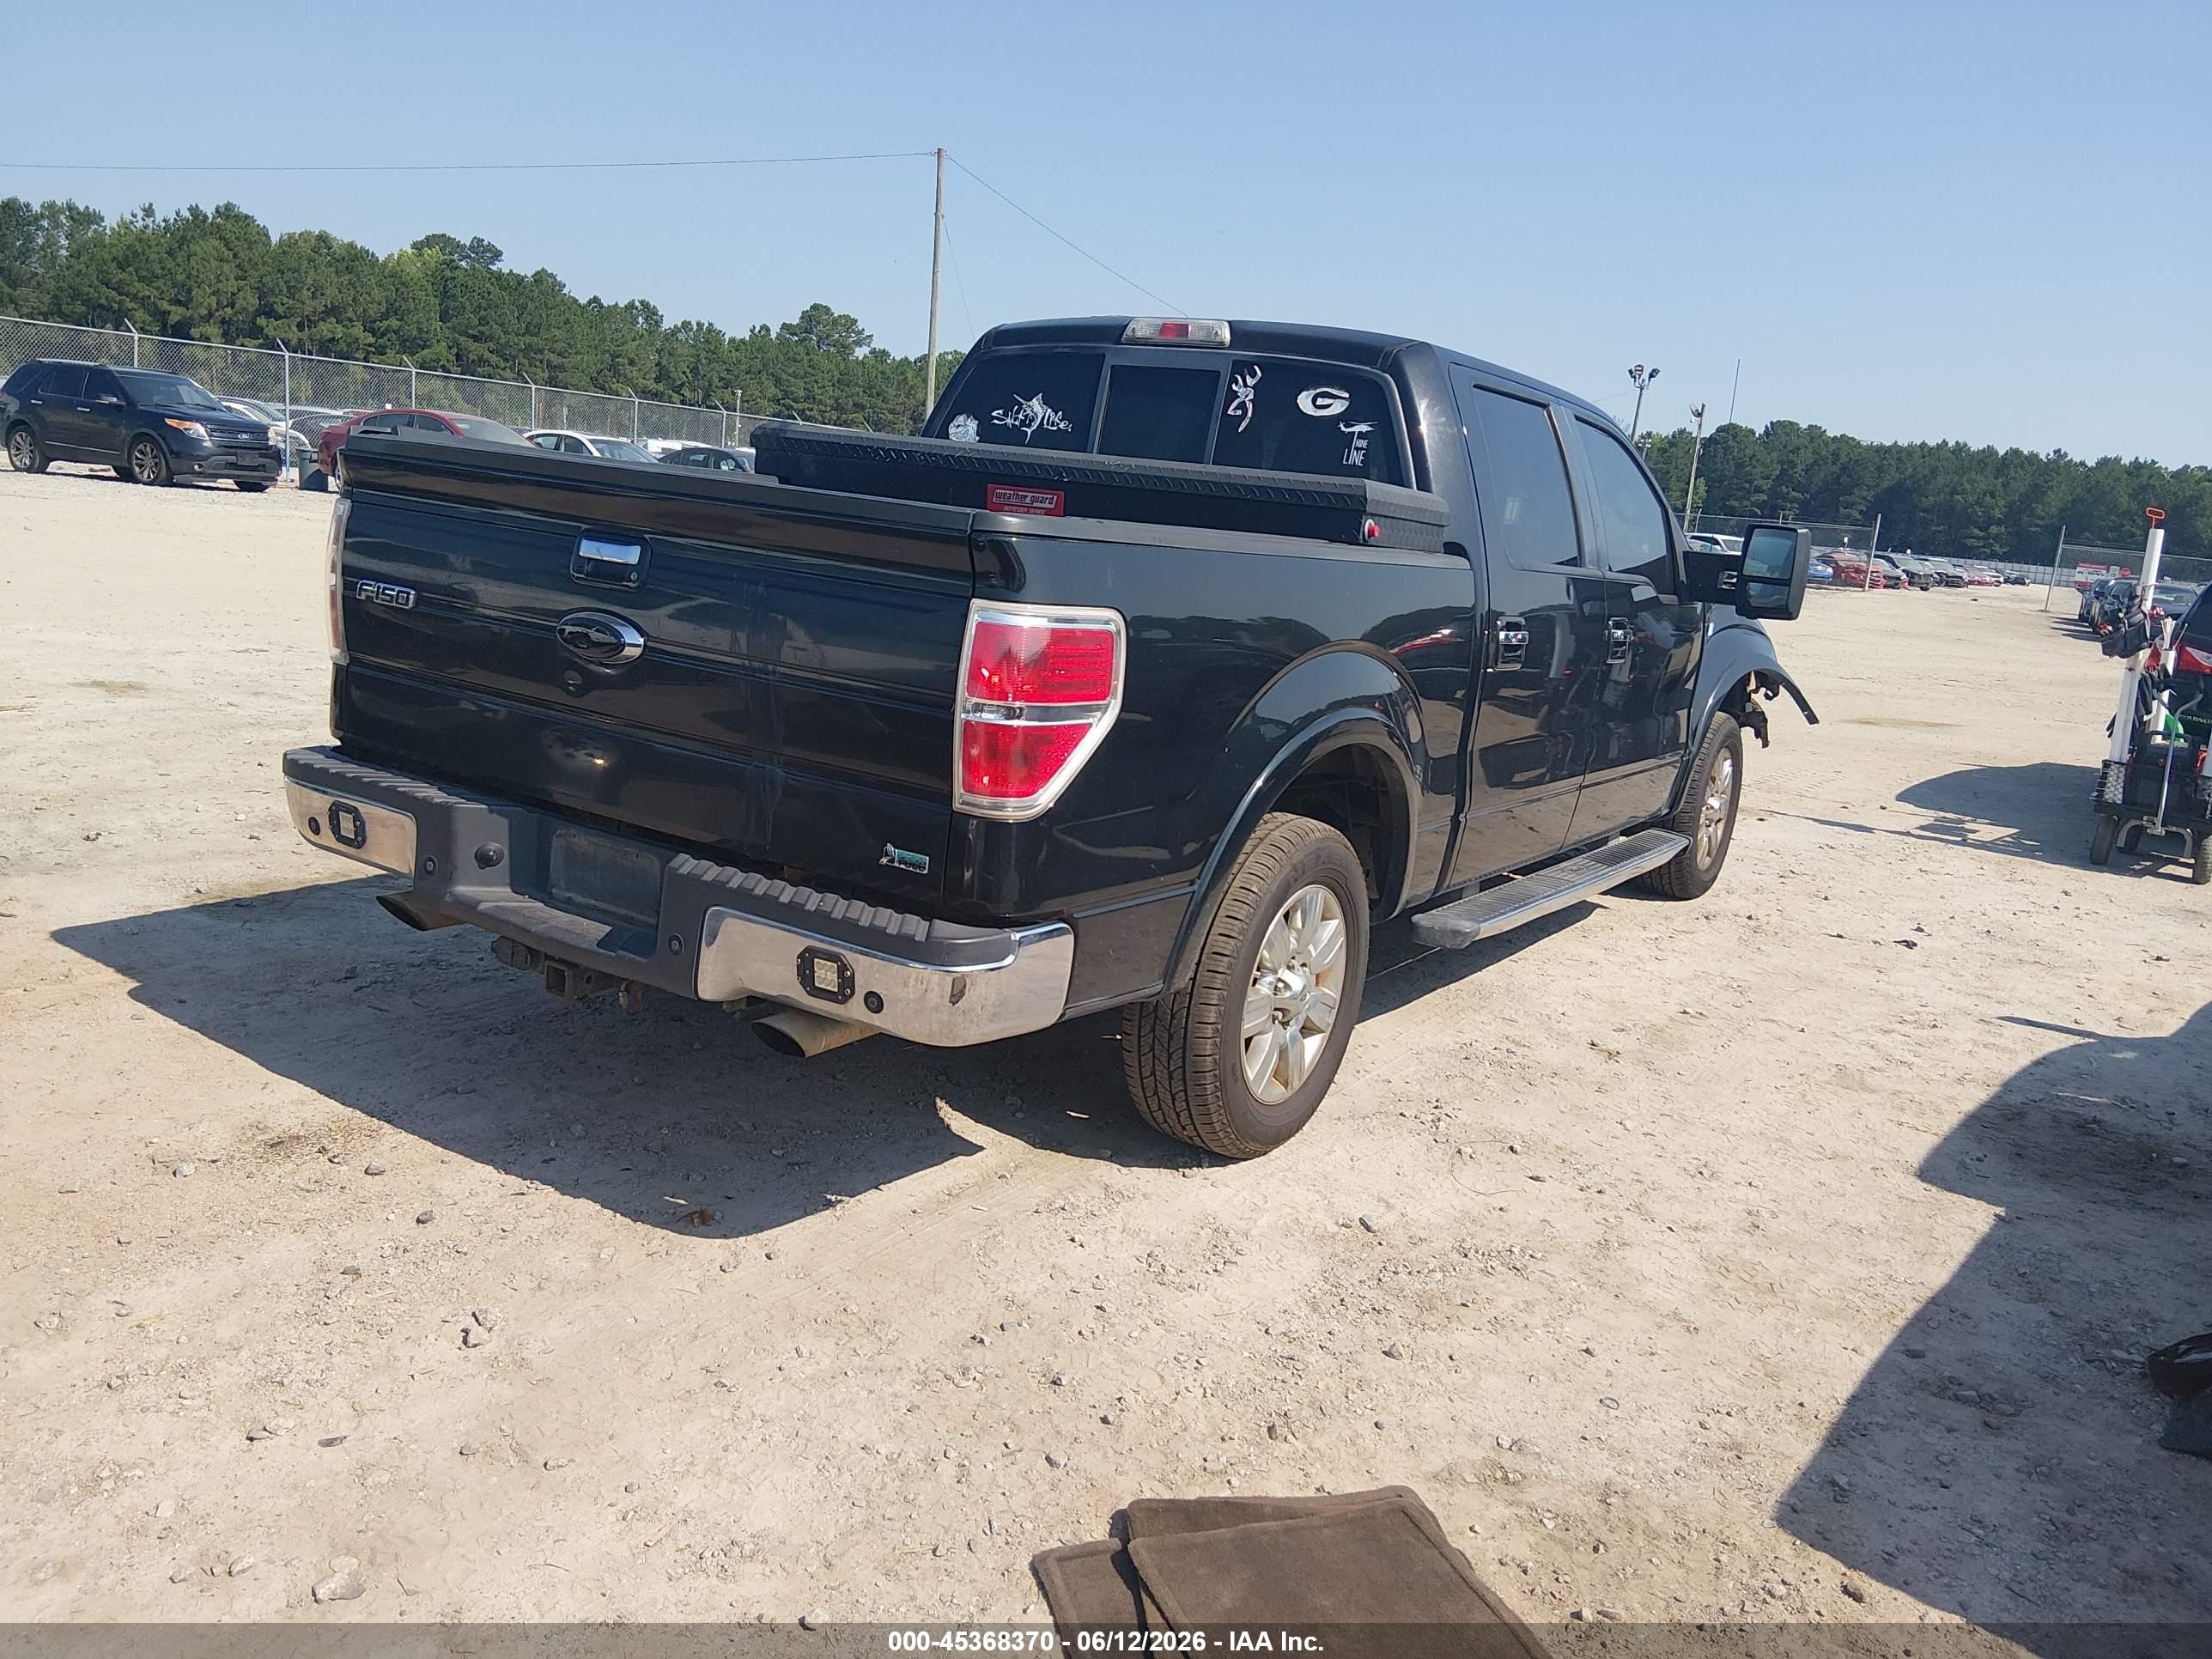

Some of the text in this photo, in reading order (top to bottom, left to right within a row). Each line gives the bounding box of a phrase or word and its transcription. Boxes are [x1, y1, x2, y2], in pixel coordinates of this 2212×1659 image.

[1355, 439, 1370, 449] NINE
[1342, 447, 1367, 466] LINE
[994, 490, 1055, 506] weather guard
